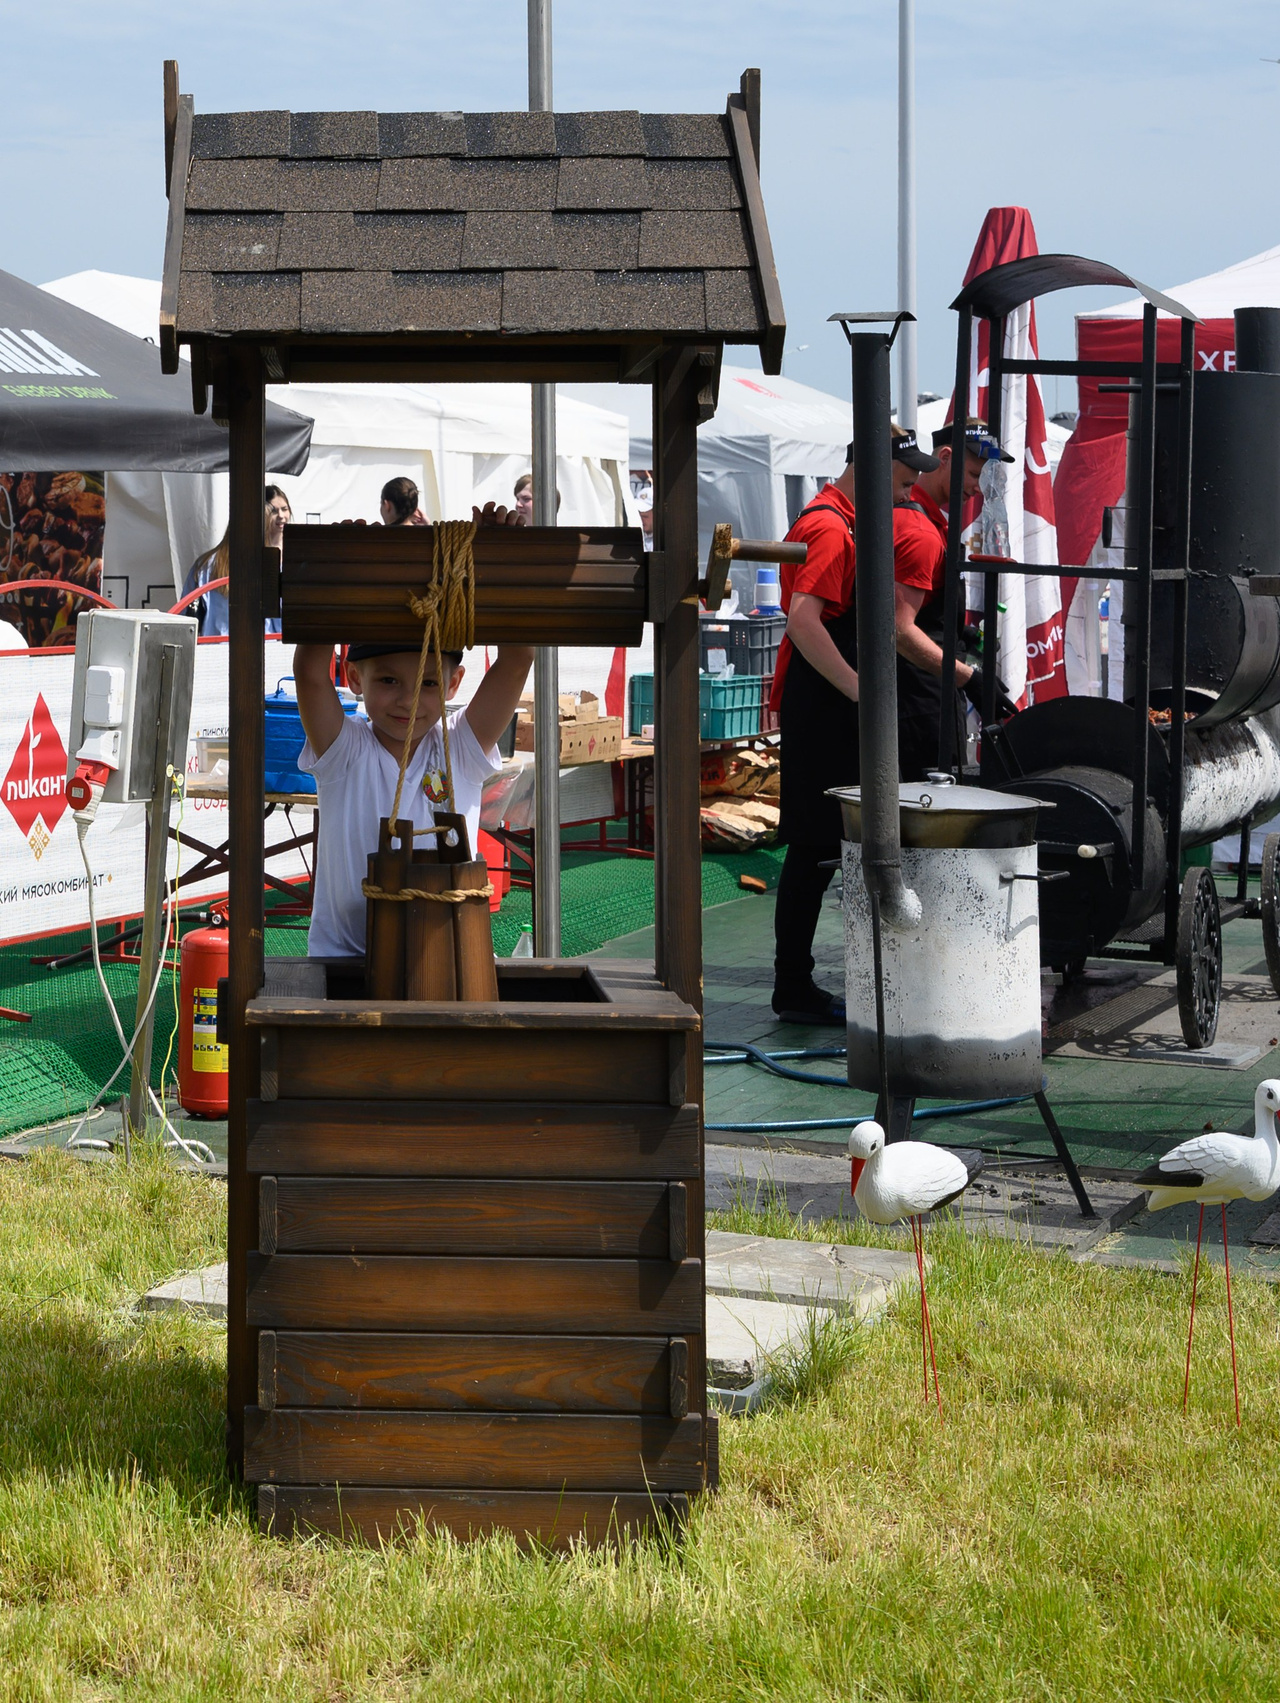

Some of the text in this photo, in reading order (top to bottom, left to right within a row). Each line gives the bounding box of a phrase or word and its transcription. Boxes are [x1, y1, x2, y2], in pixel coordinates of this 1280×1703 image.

[0, 384, 119, 400] ENERGY DRINK
[202, 726, 229, 737] ПИНСКИ
[22, 874, 105, 901] МЯСОКОМБИНАТ
